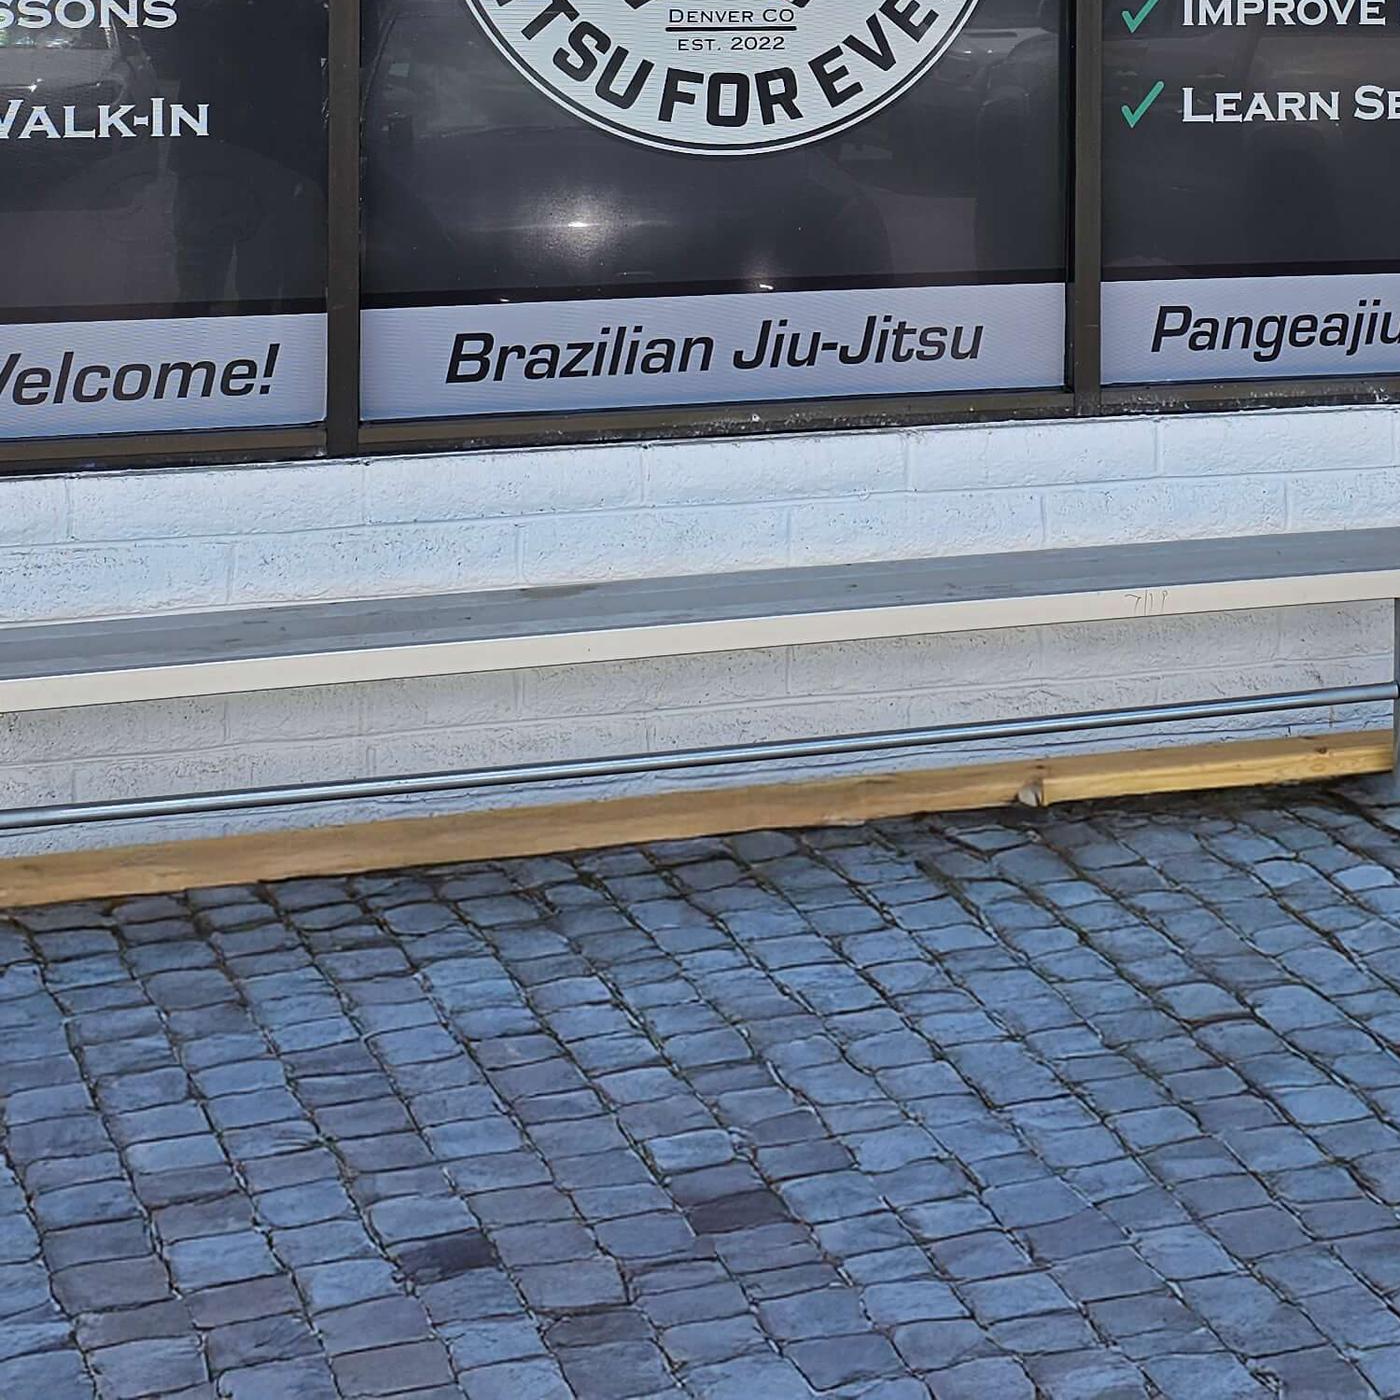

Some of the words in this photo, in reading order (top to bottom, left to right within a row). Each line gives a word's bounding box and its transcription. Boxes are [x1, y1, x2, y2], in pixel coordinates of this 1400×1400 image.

[669, 8, 754, 23] DENVER
[762, 8, 795, 23] CO
[678, 38, 721, 51] EST.
[731, 36, 785, 50] 2022
[658, 66, 803, 128] FOR
[1181, 87, 1340, 124] LEARN
[445, 325, 715, 384] Brazilian
[733, 314, 984, 369] Jiu-Jitsu
[0, 343, 280, 405] elcome!
